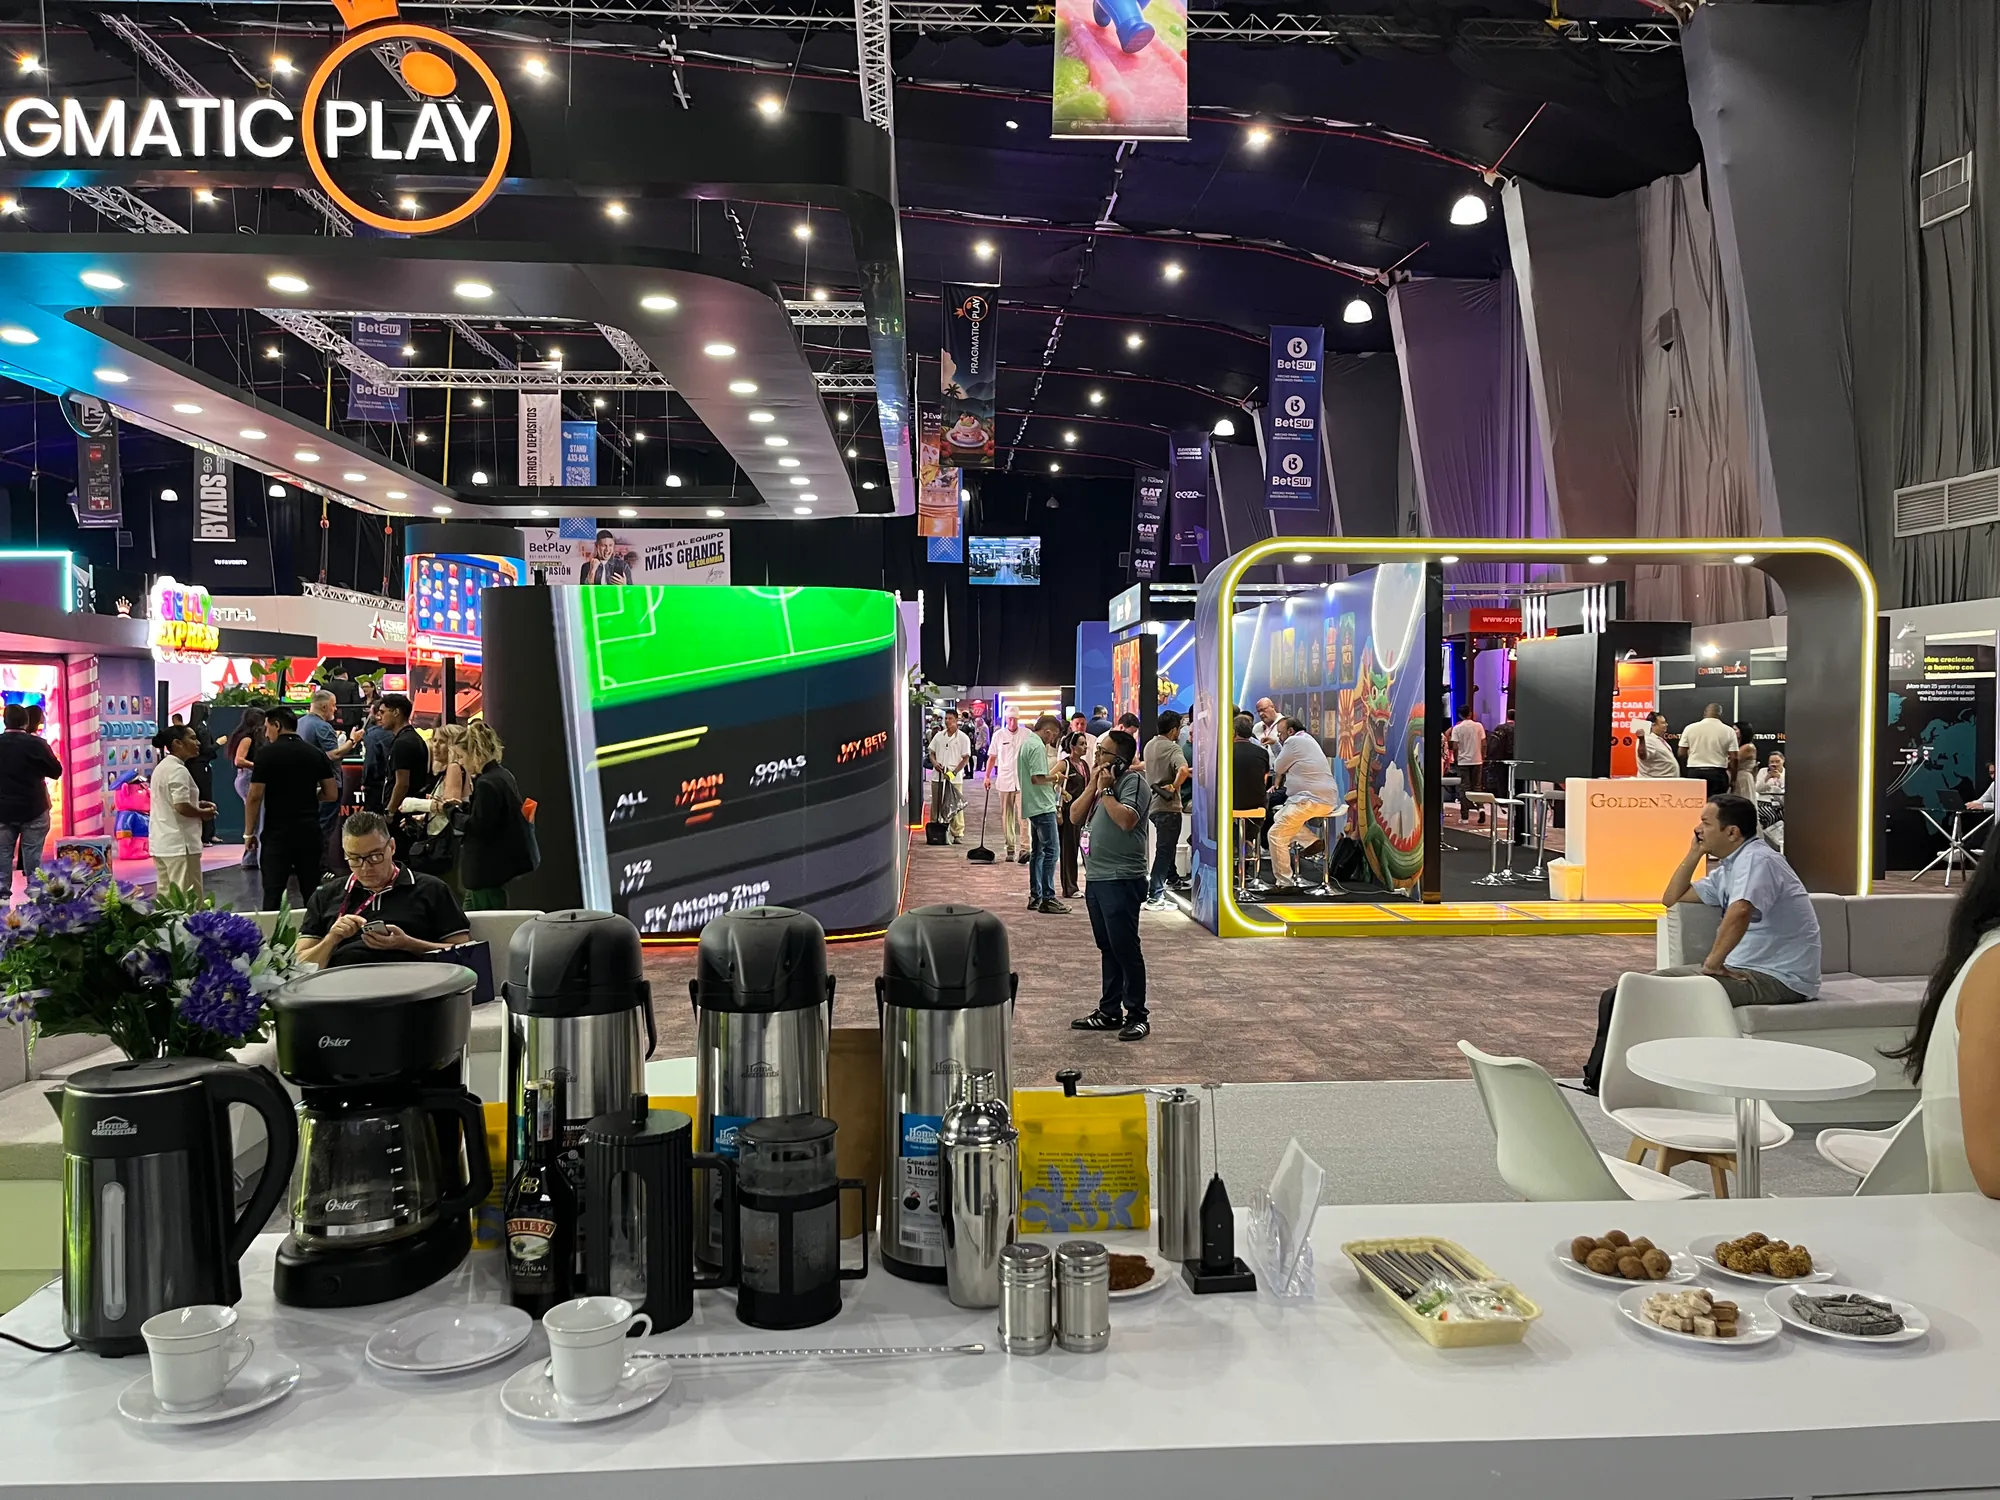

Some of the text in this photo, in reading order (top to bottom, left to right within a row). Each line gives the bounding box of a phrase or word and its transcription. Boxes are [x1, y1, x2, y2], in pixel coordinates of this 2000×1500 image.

[0, 97, 494, 163] GMATIC PLAY
[970, 297, 980, 374] PRAGMATIC PLAY
[525, 407, 537, 447] DEPÓSITOS
[569, 444, 587, 453] STAND
[1140, 487, 1163, 497] GAT
[200, 474, 229, 538] BYADS
[1137, 523, 1159, 533] GAT
[529, 542, 572, 555] BetPlay
[645, 542, 675, 554] ÚNETE
[690, 531, 724, 544] EQUIPO
[645, 540, 724, 571] MÁS GRANDE
[544, 564, 571, 576] PASIÓN
[1134, 559, 1156, 569] GAT
[161, 588, 213, 624] JELLY
[156, 620, 220, 651] EXPRESS
[1622, 701, 1643, 709] CADA
[840, 730, 888, 754] MY BETS
[755, 754, 807, 777] GOALS
[681, 772, 724, 793] MAIN
[616, 789, 648, 807] ALL
[338, 804, 350, 817] N
[624, 859, 653, 877] 1X2
[644, 879, 771, 925] FK Aktobe Zhas
[318, 1035, 351, 1048] Oster
[740, 1070, 779, 1078] elements
[746, 1063, 773, 1073] Home
[91, 1127, 138, 1136] elements
[96, 1120, 129, 1131] Home
[904, 1134, 938, 1144] elemen
[906, 1165, 912, 1175] 3
[325, 1198, 359, 1212] Oster
[506, 1219, 551, 1234] BAILEYS
